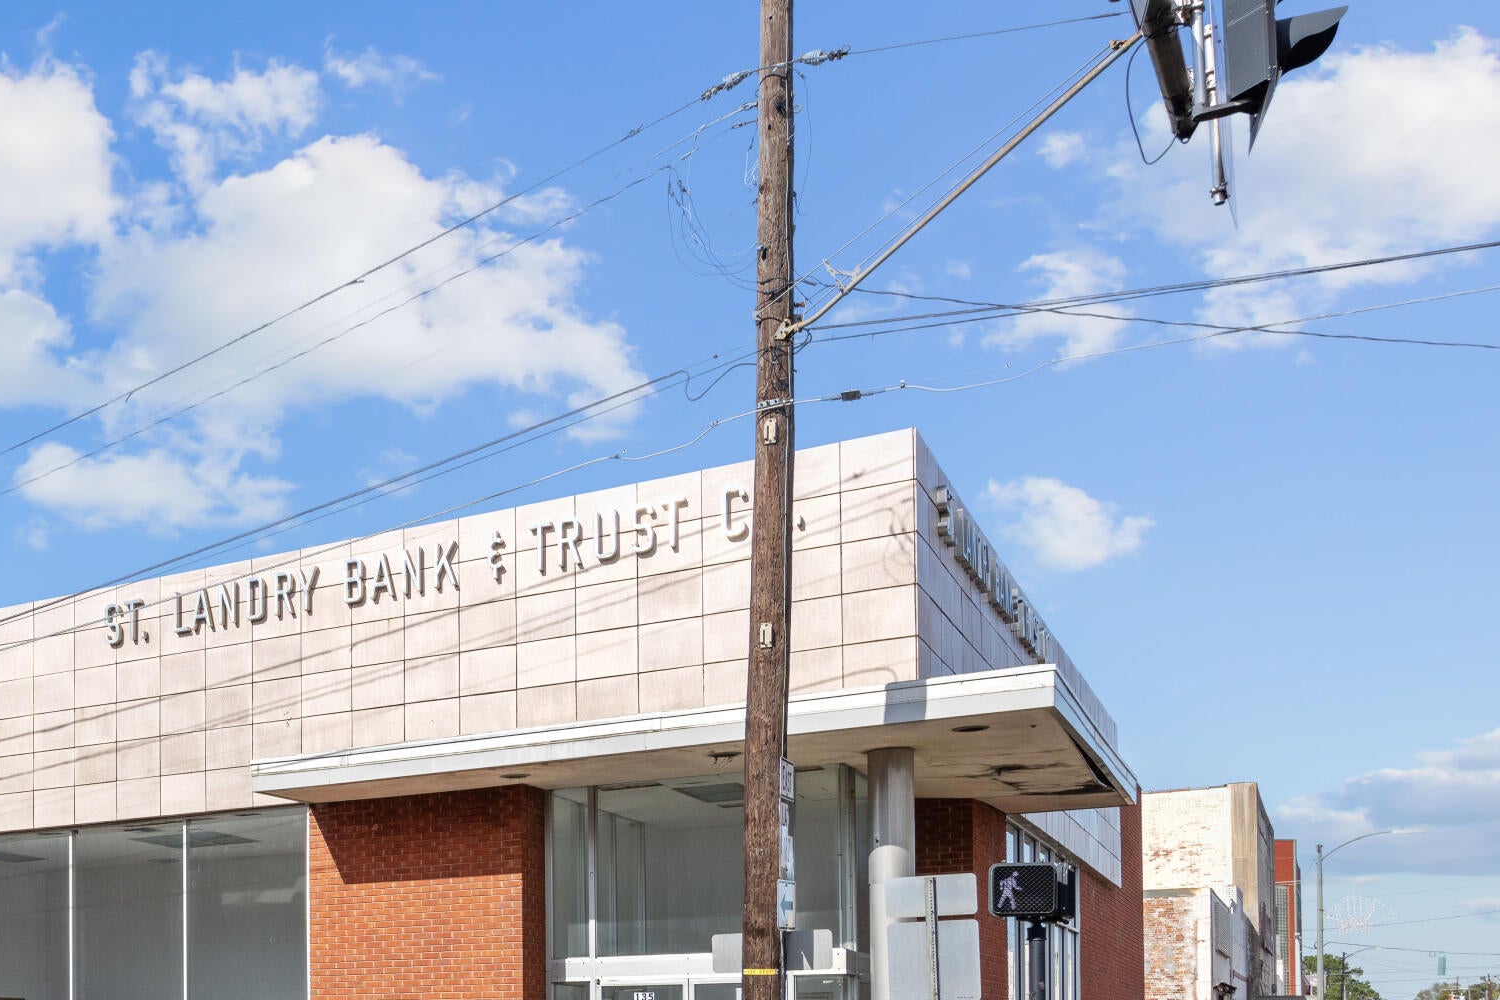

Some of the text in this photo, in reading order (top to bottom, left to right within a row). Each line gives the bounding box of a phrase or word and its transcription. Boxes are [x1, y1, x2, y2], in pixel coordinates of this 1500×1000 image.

[104, 598, 150, 648] ST.
[173, 566, 320, 636] LANDRY
[343, 540, 461, 609] BANK
[487, 530, 507, 585] &
[529, 496, 689, 578] TRUST
